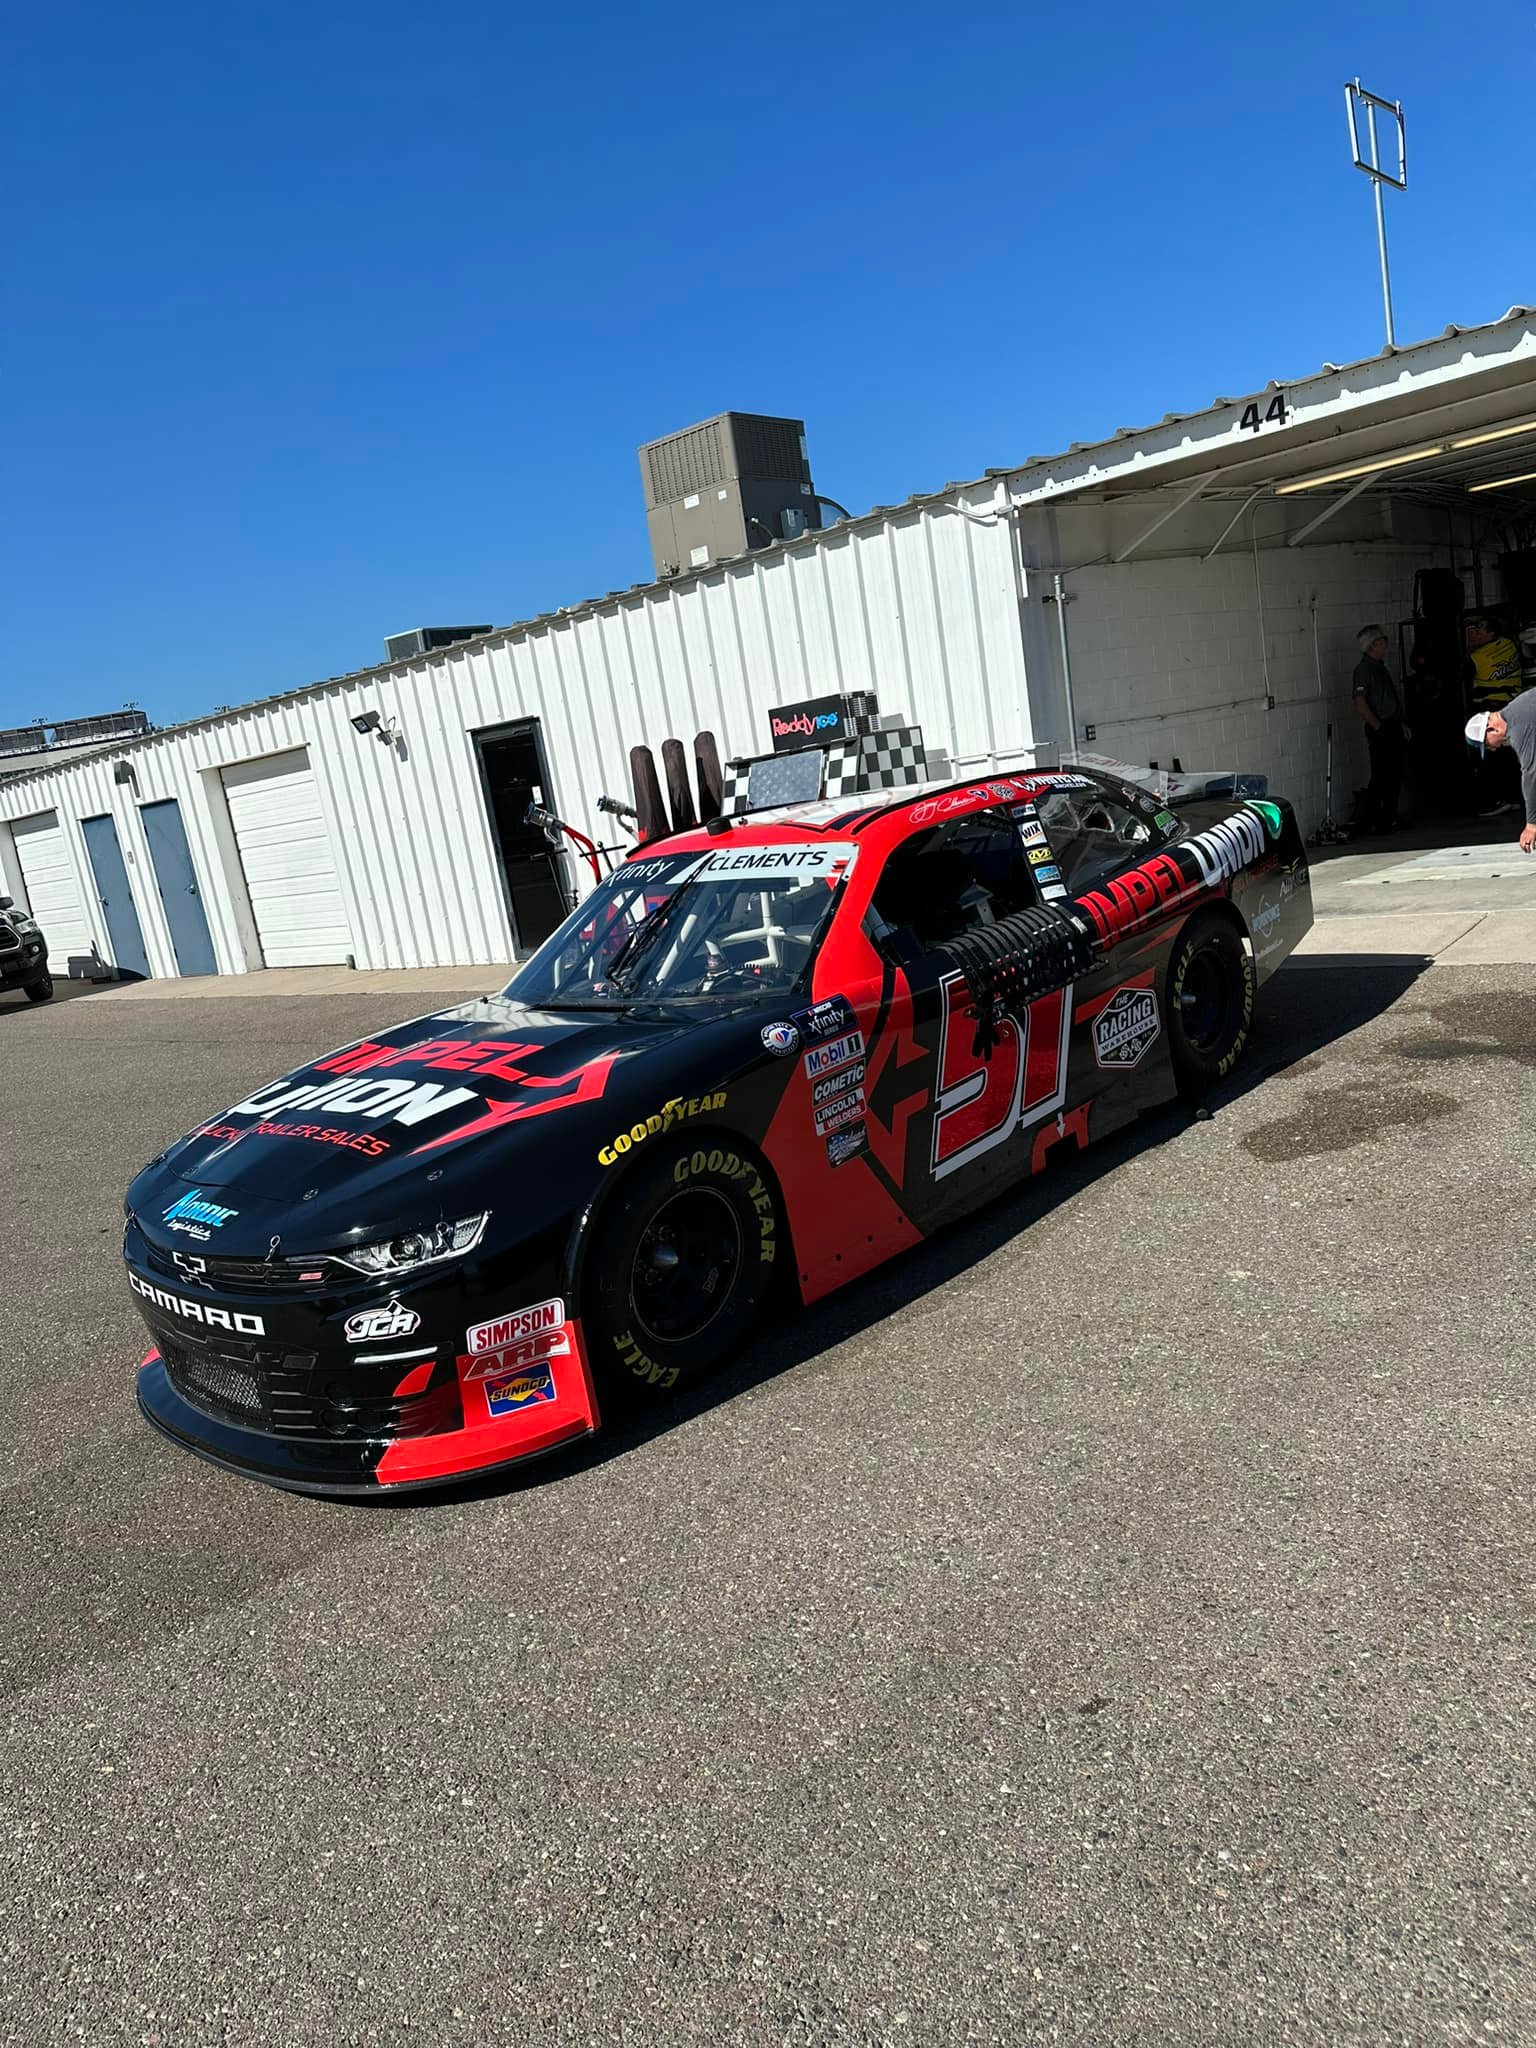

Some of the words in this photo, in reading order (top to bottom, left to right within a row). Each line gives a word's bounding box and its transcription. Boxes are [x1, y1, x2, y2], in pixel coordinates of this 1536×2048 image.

[1239, 394, 1290, 433] 44
[1021, 823, 1041, 839] WIX
[1177, 808, 1265, 887] UNION
[607, 858, 674, 887] xfinity
[707, 851, 827, 871] CLEMENTS
[1074, 854, 1198, 950] IMPEL
[1115, 993, 1130, 1008] THE
[808, 1009, 845, 1034] xfinity
[1100, 998, 1152, 1042] RACING
[1102, 1019, 1154, 1052] WAREHOUSE
[808, 1042, 845, 1074] Mobil
[930, 967, 1073, 1182] 51
[814, 1065, 865, 1101] COMETIC
[226, 1077, 478, 1127] UNION
[817, 1094, 856, 1123] LINCOLN
[827, 1105, 861, 1128] WELDERS
[313, 1129, 391, 1156] SALES
[598, 1092, 728, 1166] GOODYEAR
[673, 1150, 775, 1263] GOODYEAR
[128, 1271, 265, 1336] CAMARO
[476, 1305, 555, 1350] SIMPSON
[464, 1332, 567, 1380] ARP
[613, 1330, 680, 1388] EAGLE
[491, 1376, 550, 1401] SUNOCO
